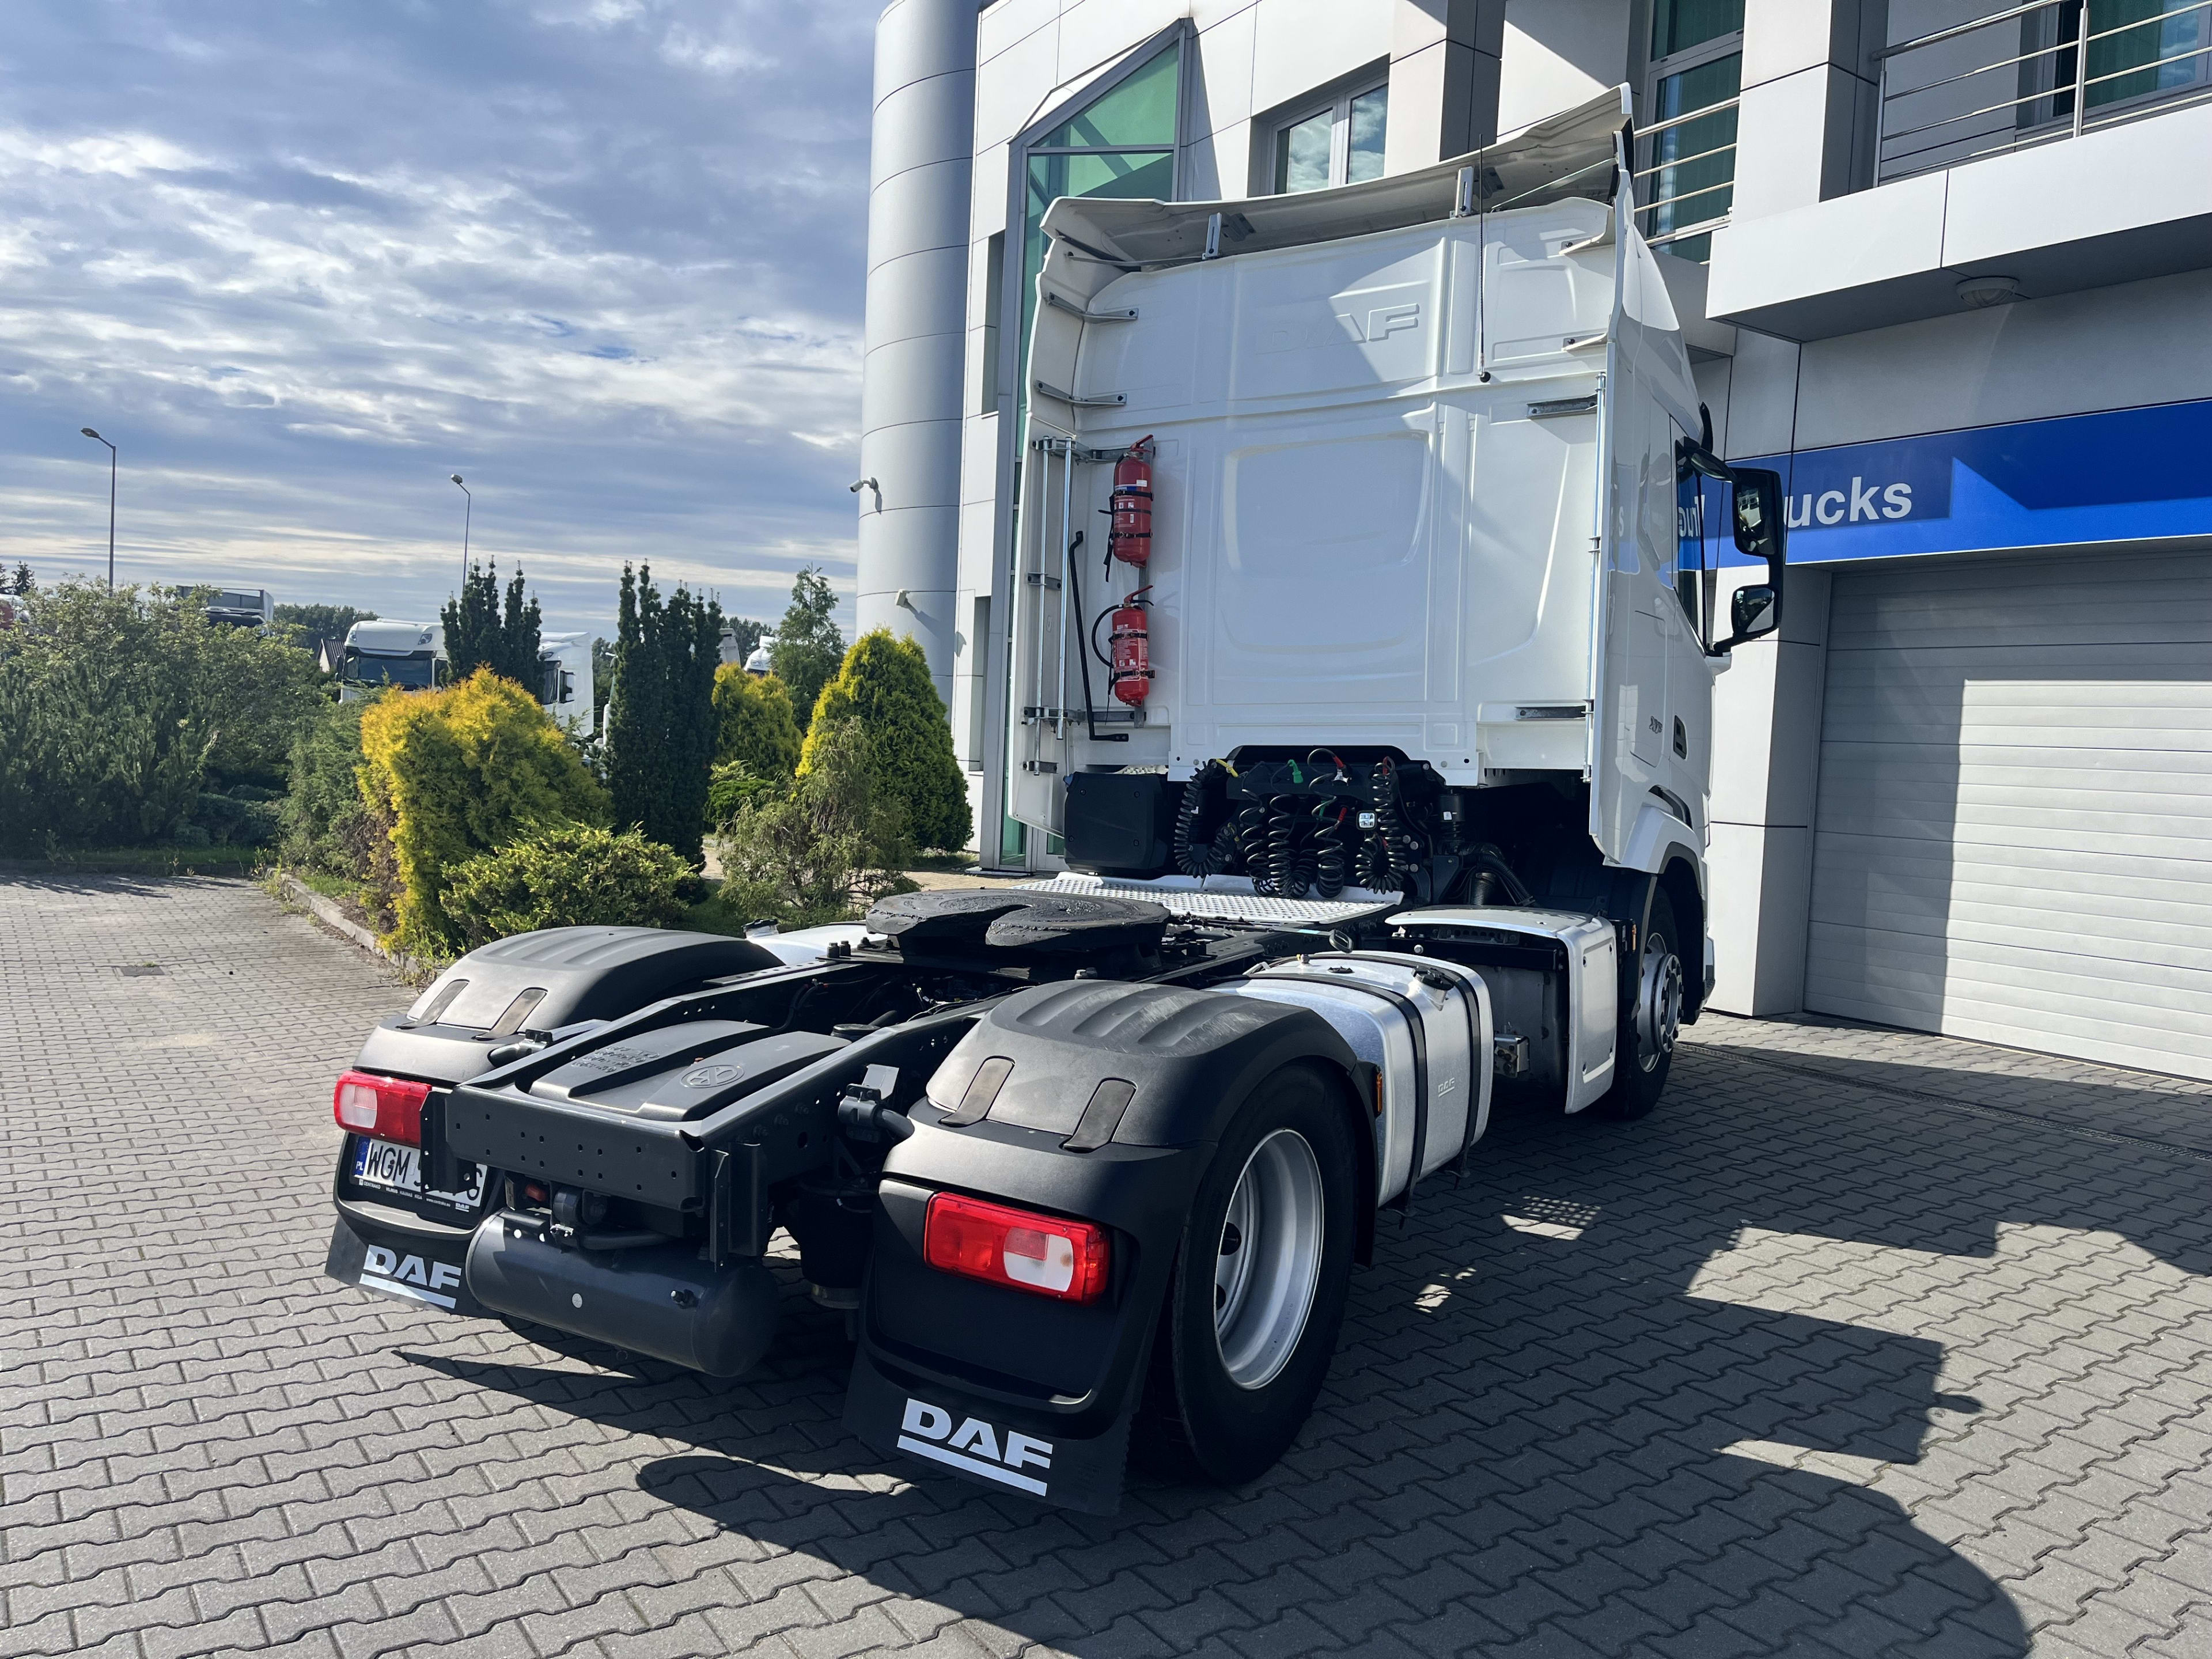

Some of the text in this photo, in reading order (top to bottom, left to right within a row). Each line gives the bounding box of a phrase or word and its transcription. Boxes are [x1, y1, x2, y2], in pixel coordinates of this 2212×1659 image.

[1783, 476, 1912, 528] ucks
[355, 1161, 364, 1171] PL
[367, 1142, 411, 1184] WGM
[363, 1244, 462, 1289] DAF
[902, 1397, 1054, 1469] DAF
